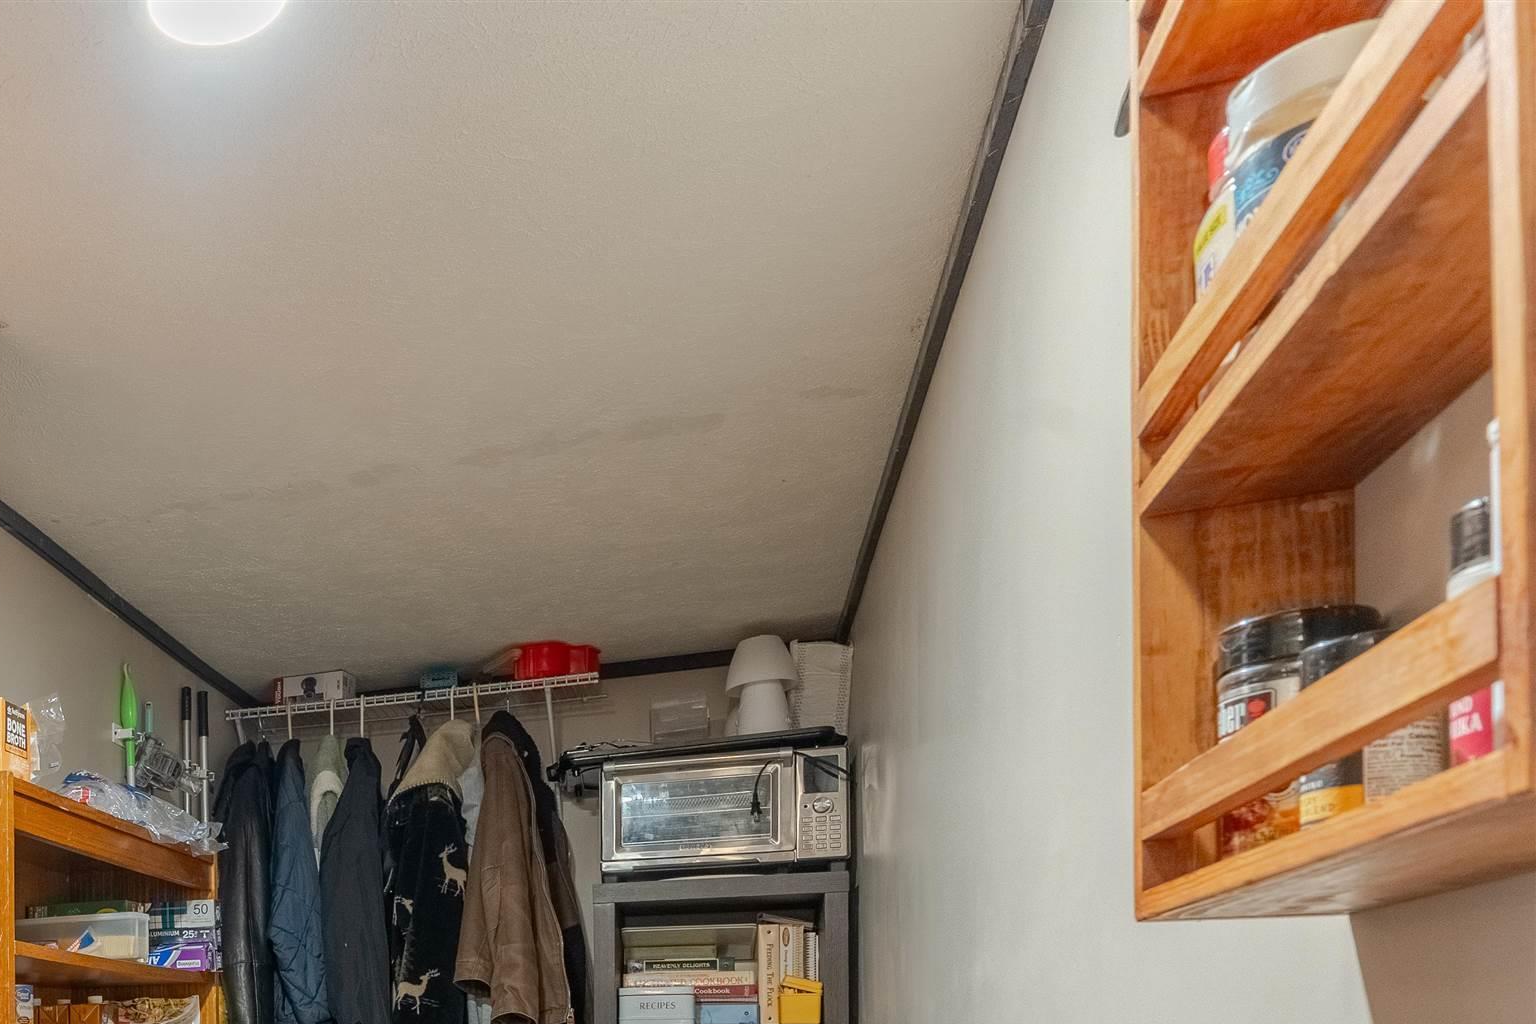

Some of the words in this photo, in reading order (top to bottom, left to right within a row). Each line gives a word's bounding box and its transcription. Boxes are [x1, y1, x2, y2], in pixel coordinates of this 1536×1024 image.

[6, 717, 26, 738] BONE
[6, 731, 26, 750] BROTH
[193, 903, 209, 915] 50
[682, 961, 711, 969] DELIGHTS
[694, 987, 731, 995] Cookbook
[639, 1001, 677, 1011] RECIPES
